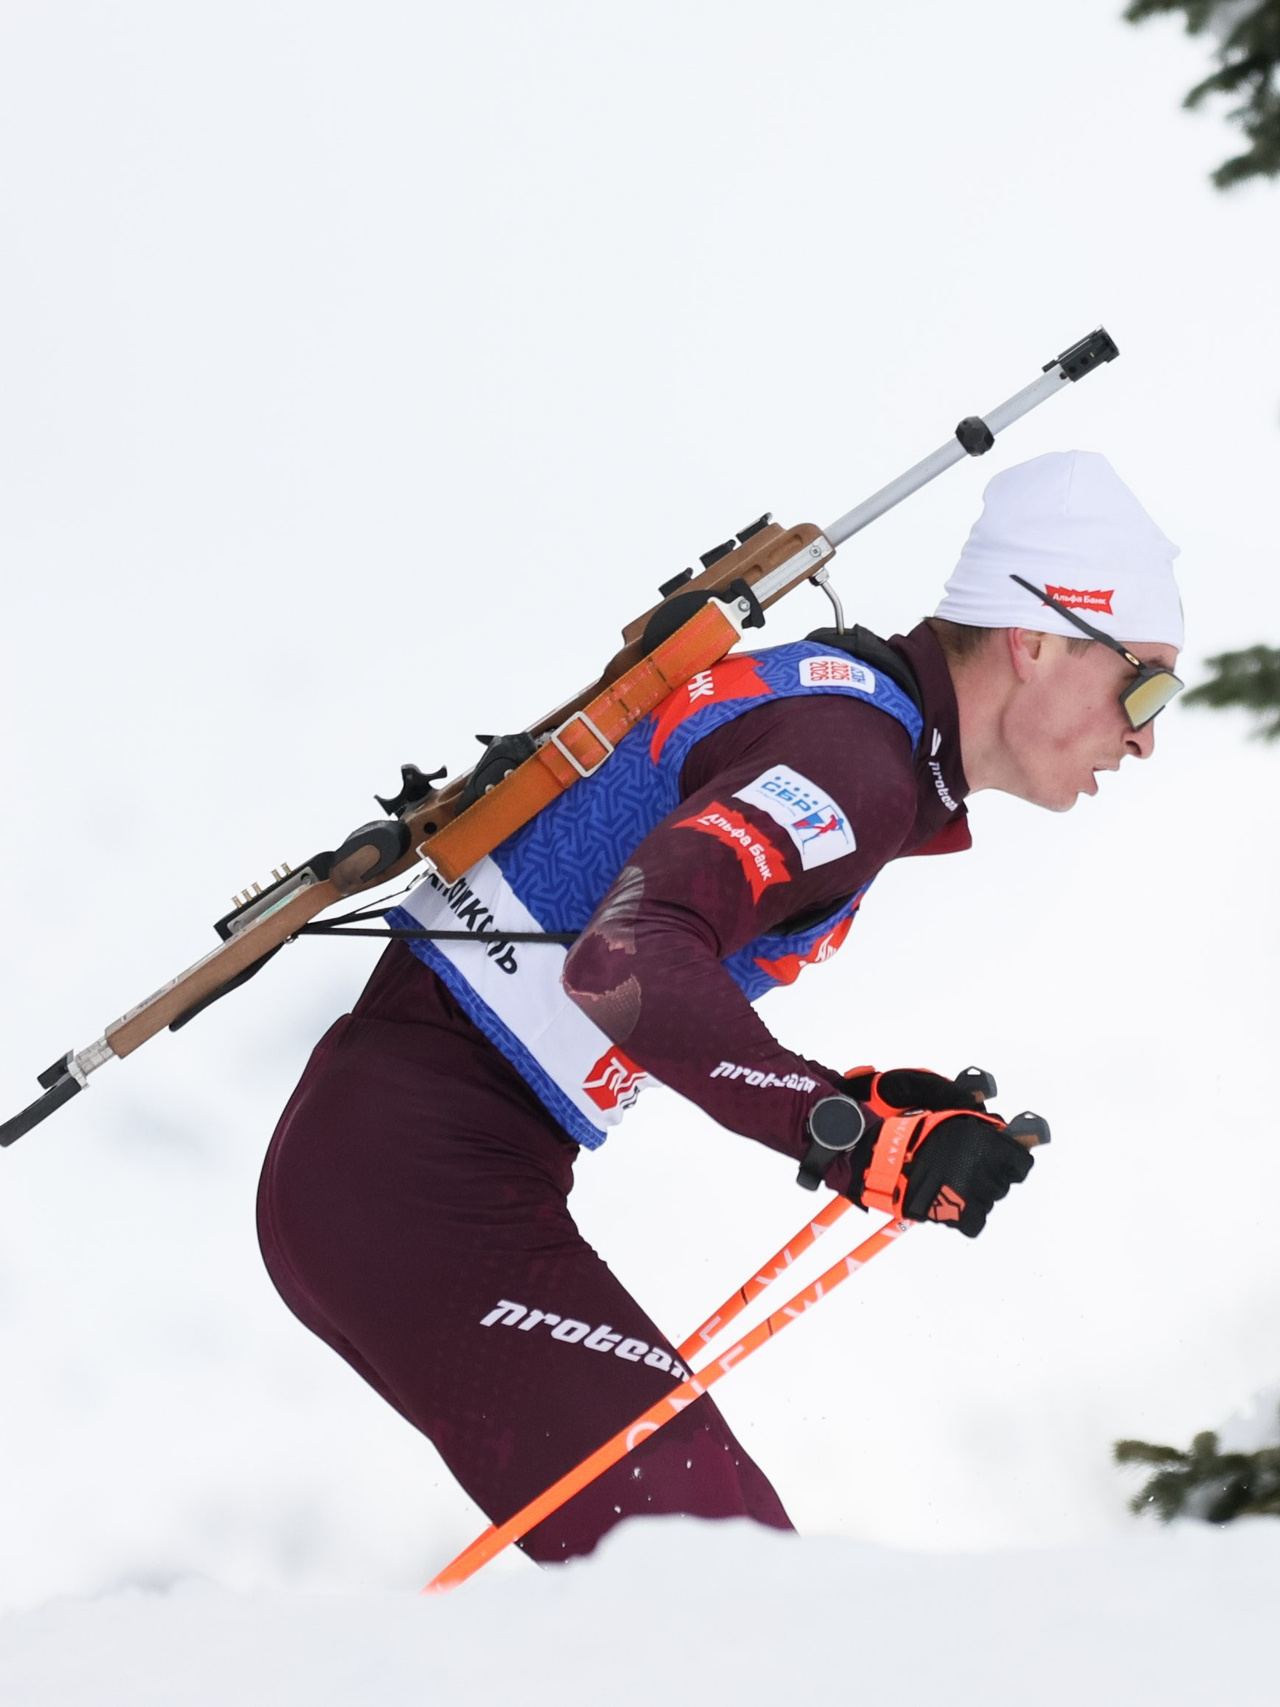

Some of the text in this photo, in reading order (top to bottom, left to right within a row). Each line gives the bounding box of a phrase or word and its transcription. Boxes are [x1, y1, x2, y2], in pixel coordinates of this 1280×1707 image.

[1052, 592, 1107, 605] Альфа Банк
[809, 660, 829, 681] 2026
[761, 781, 811, 812] СБР
[696, 813, 773, 882] Альфа Банк
